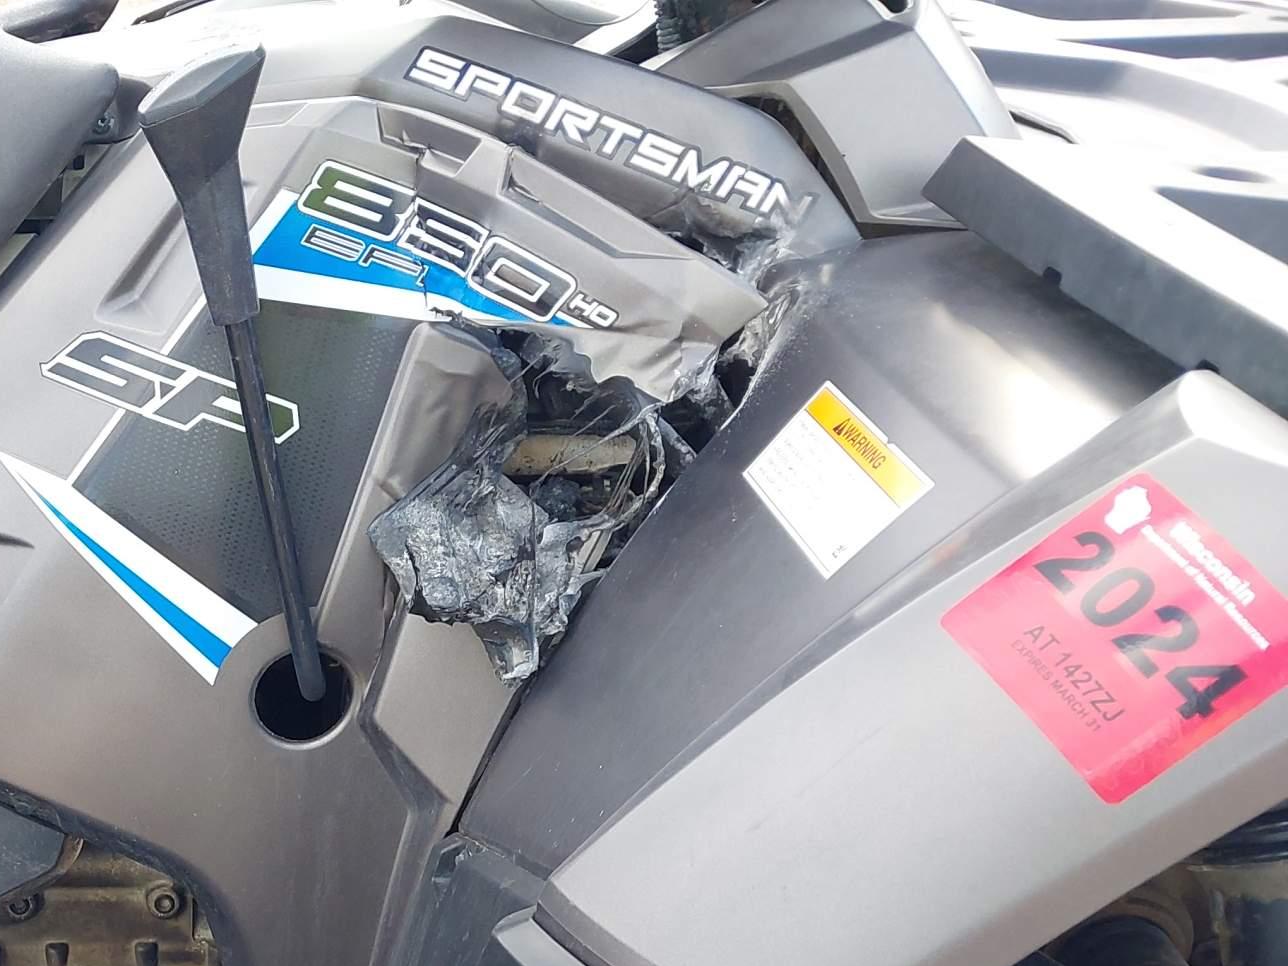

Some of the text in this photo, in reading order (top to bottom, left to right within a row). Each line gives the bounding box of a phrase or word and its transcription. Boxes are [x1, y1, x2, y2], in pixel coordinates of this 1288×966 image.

[411, 47, 816, 224] SPORTSMAN
[297, 159, 580, 321] 850
[40, 330, 300, 445] SP
[842, 423, 887, 470] WARNING
[1169, 521, 1256, 607] Wisconsin
[1023, 625, 1126, 722] AT 1427ZJ
[1035, 531, 1248, 720] 2024
[1011, 639, 1054, 682] EXPIRES
[1050, 679, 1090, 719] MARCH
